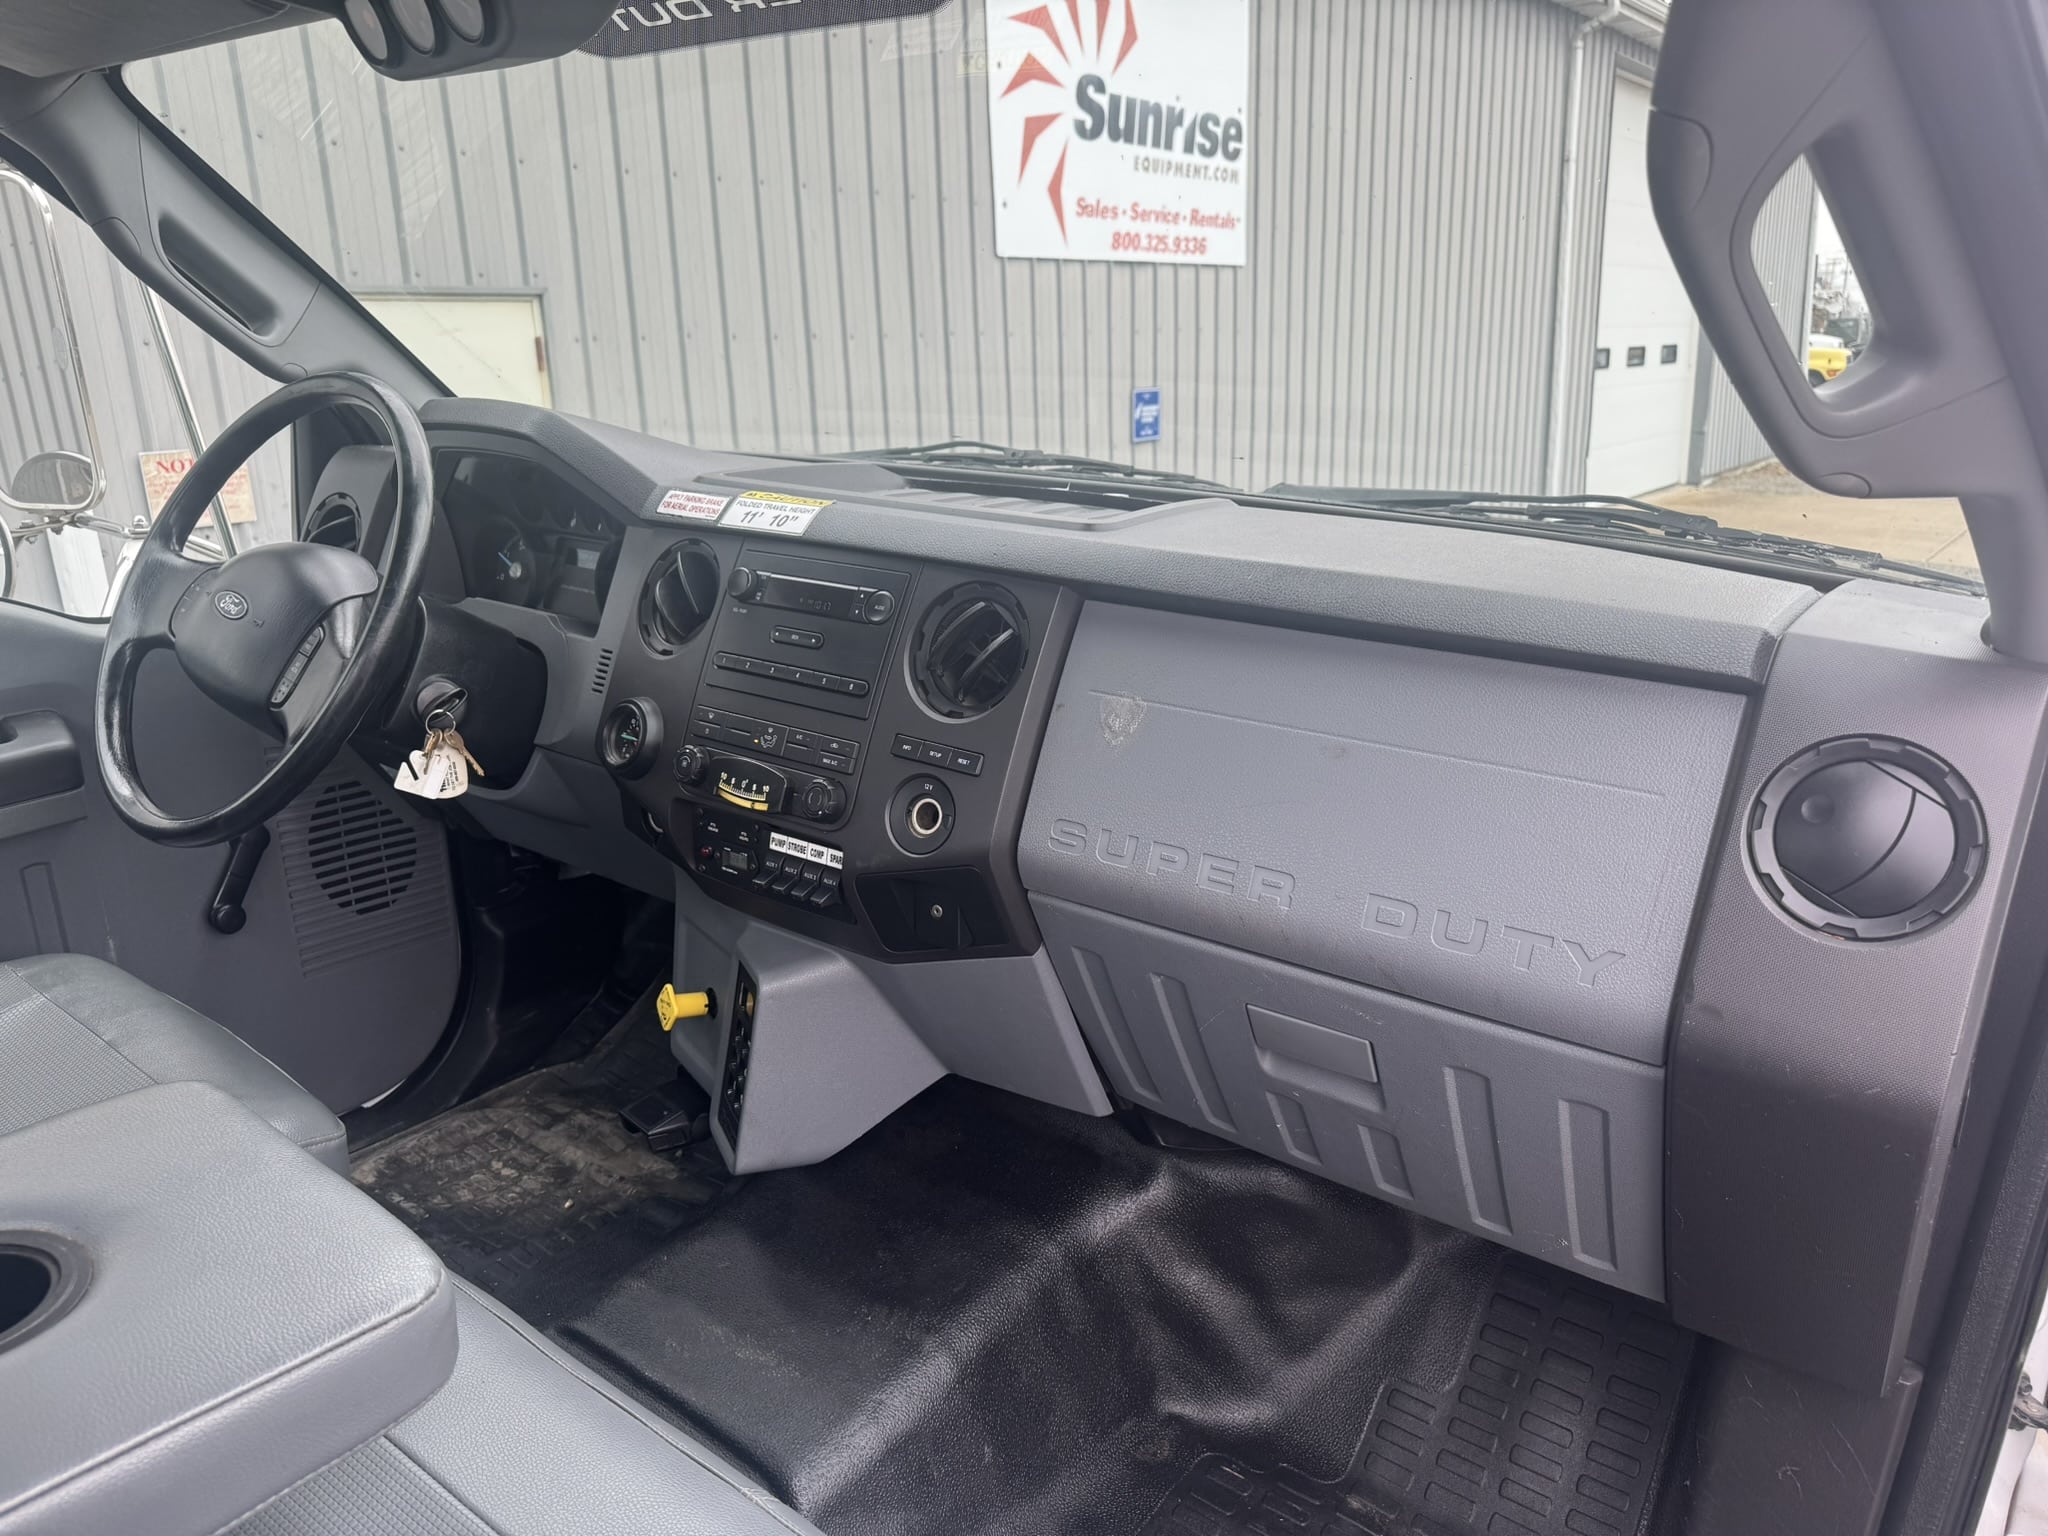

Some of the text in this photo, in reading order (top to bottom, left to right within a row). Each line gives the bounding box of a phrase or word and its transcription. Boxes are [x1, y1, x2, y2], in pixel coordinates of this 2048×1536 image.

[1073, 73, 1243, 162] Sunrise
[1133, 155, 1240, 184] EQUIPMENT.COM
[1076, 196, 1236, 230] Sales Service Rentals
[736, 500, 816, 515] FOLDED TRAVEL HEIGHT
[771, 836, 786, 849] PUMP
[787, 841, 807, 855] STROBE
[809, 848, 825, 860] COMP
[1048, 817, 1626, 988] SUPER DUTY
